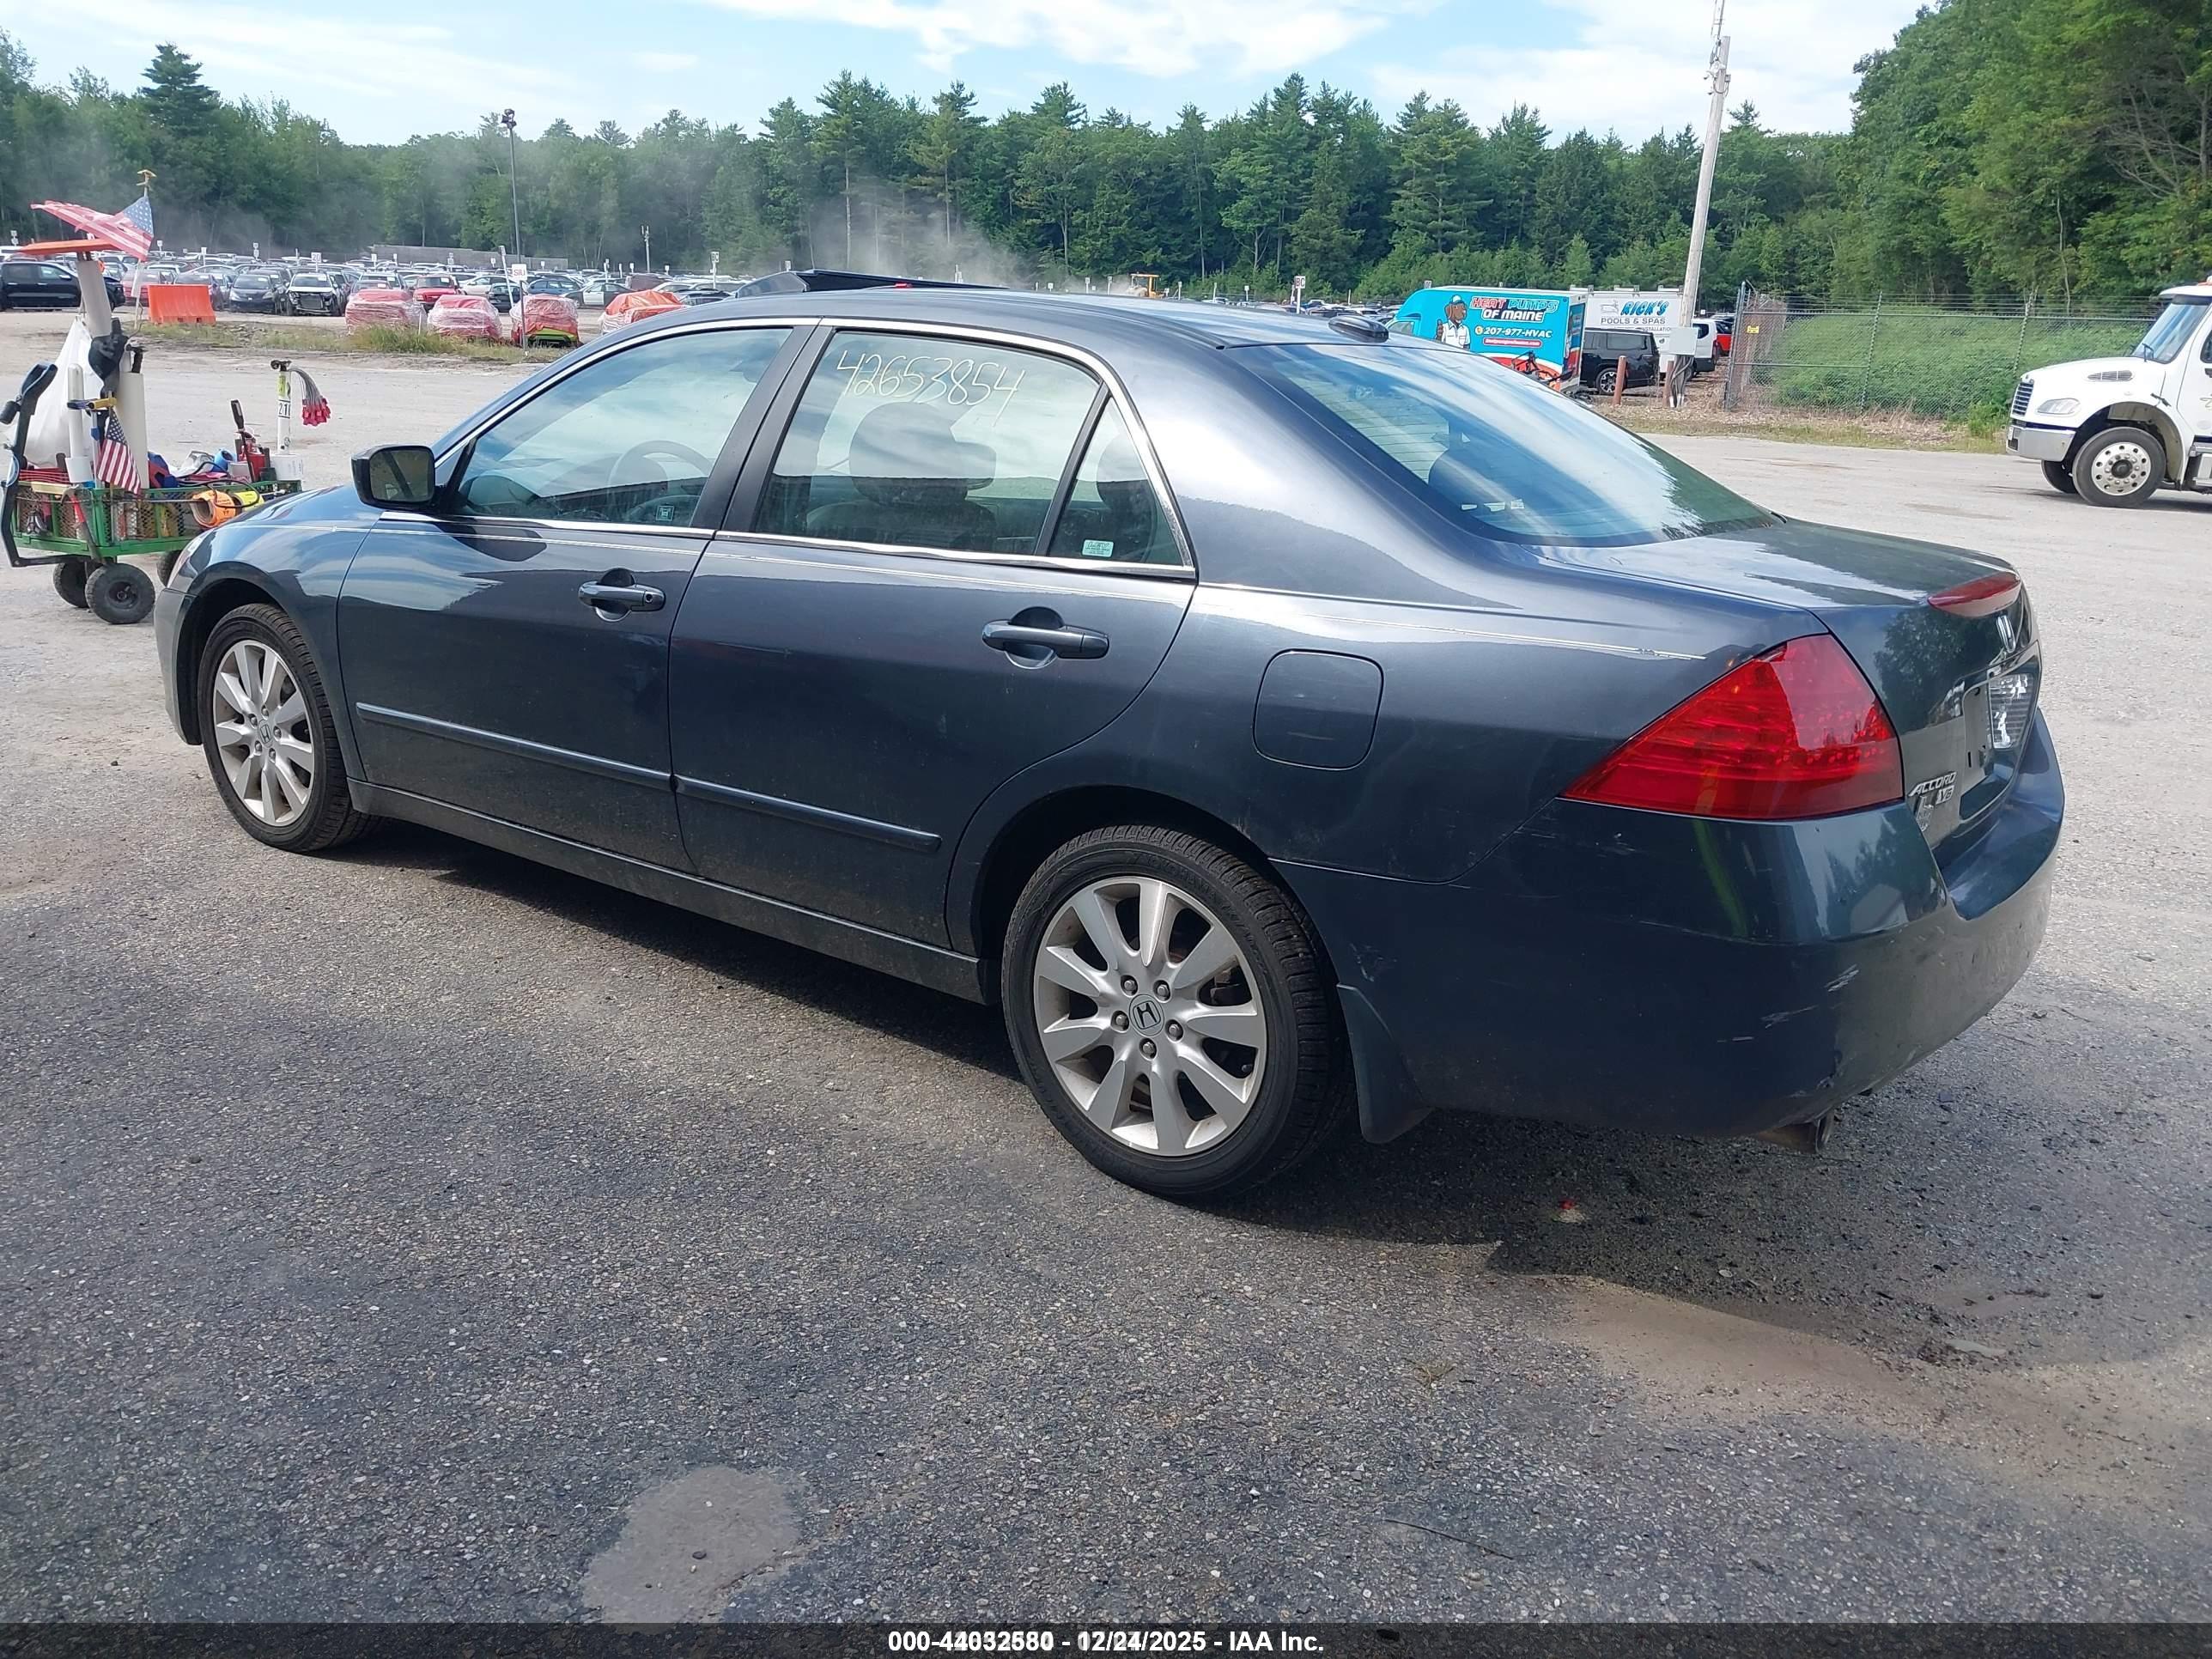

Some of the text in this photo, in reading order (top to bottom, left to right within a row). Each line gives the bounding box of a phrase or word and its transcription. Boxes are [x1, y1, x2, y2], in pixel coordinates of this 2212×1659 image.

[1296, 277, 1305, 287] BC
[1472, 297, 1559, 312] HEAT PUMPS
[1620, 301, 1669, 316] RICK'S
[1483, 309, 1544, 321] OF MAINE
[1484, 327, 1553, 338] 207-977-HVAC
[836, 349, 1026, 427] 42653854
[1908, 772, 1957, 797] ACCORD
[1936, 785, 1954, 805] V6
